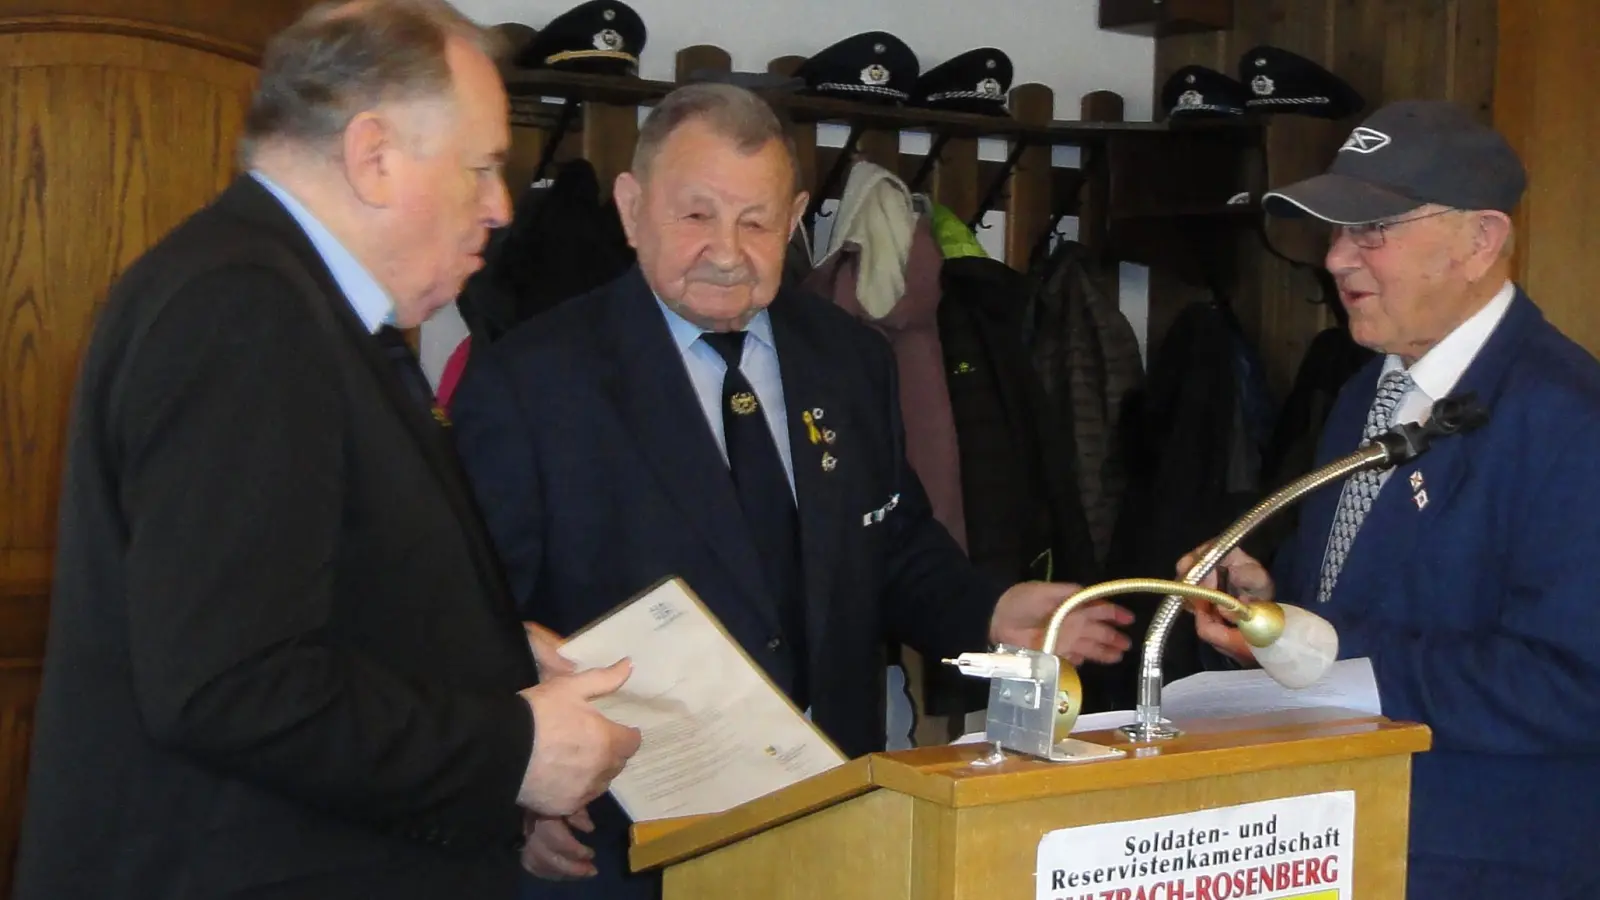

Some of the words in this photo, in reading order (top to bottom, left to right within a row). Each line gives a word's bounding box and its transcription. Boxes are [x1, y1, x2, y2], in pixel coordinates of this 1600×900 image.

[1124, 827, 1230, 856] Soldaten-
[1239, 814, 1277, 839] und
[1051, 827, 1340, 890] Reservistenkameradschaft
[1054, 854, 1339, 900] ACH-ROSENBERG
